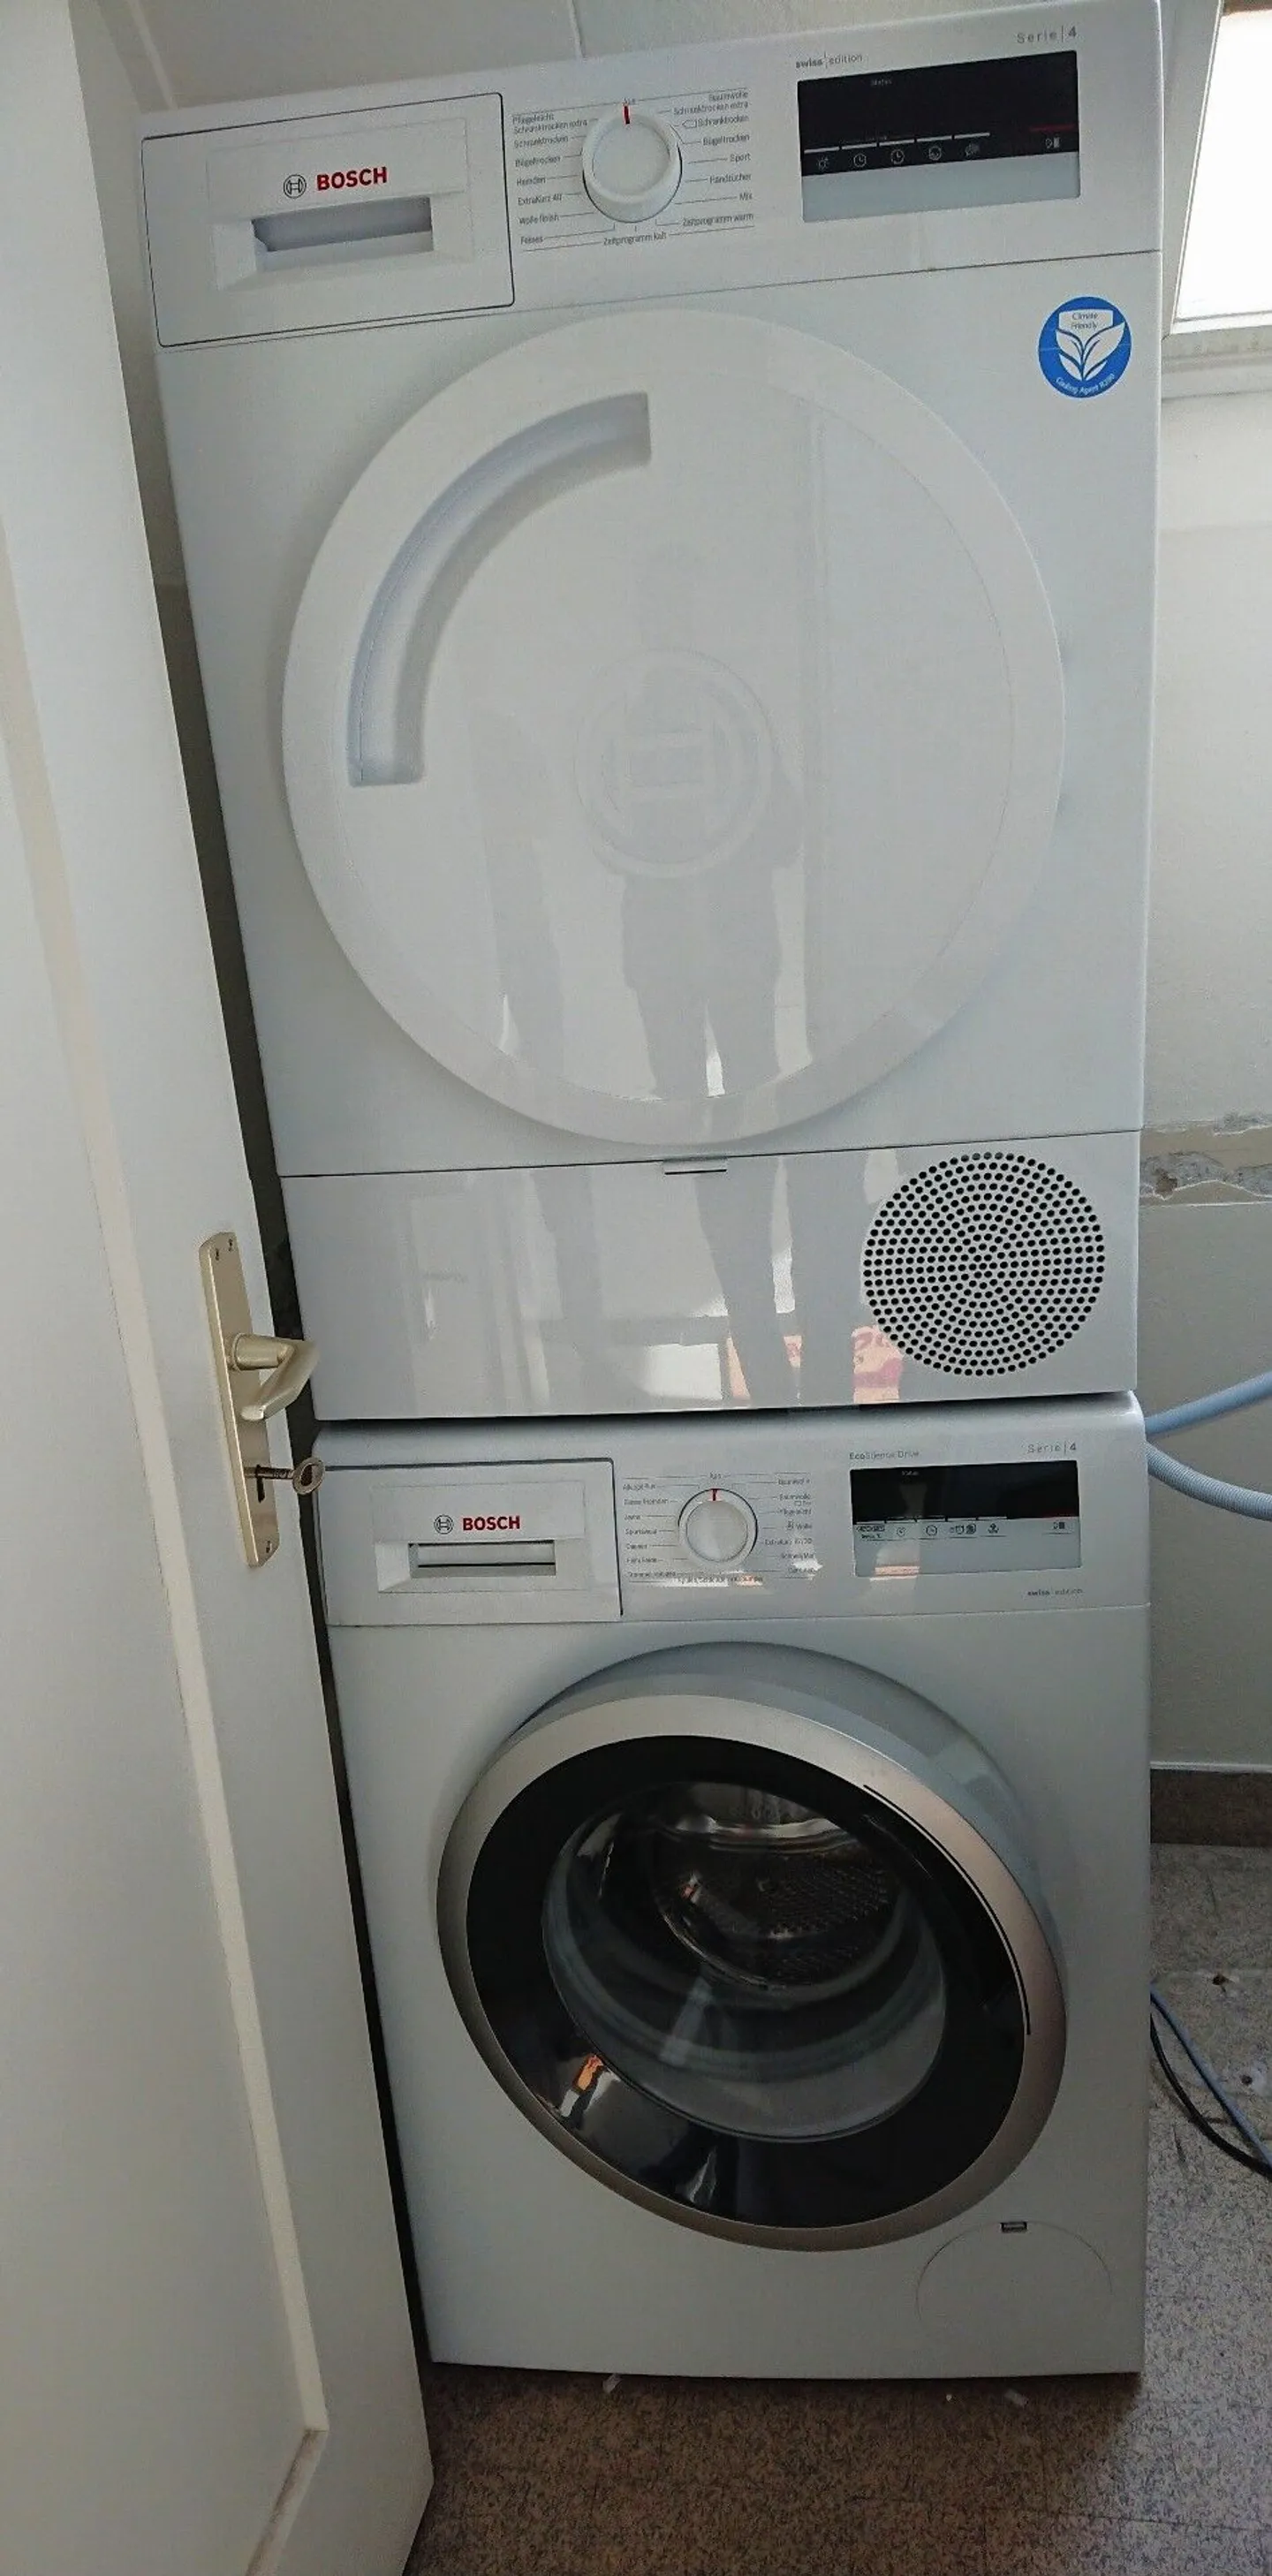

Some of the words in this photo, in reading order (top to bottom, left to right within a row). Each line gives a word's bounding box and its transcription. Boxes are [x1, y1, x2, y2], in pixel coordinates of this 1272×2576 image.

[1016, 30, 1057, 44] Serie
[1067, 26, 1078, 39] 4
[795, 57, 823, 69] swiss
[829, 53, 863, 65] edition
[730, 154, 751, 163] Sport
[316, 166, 388, 191] BOSCH
[739, 193, 753, 201] Mix
[1027, 1443, 1061, 1453] Serie
[1069, 1442, 1077, 1451] 4
[462, 1516, 520, 1531] BOSCH
